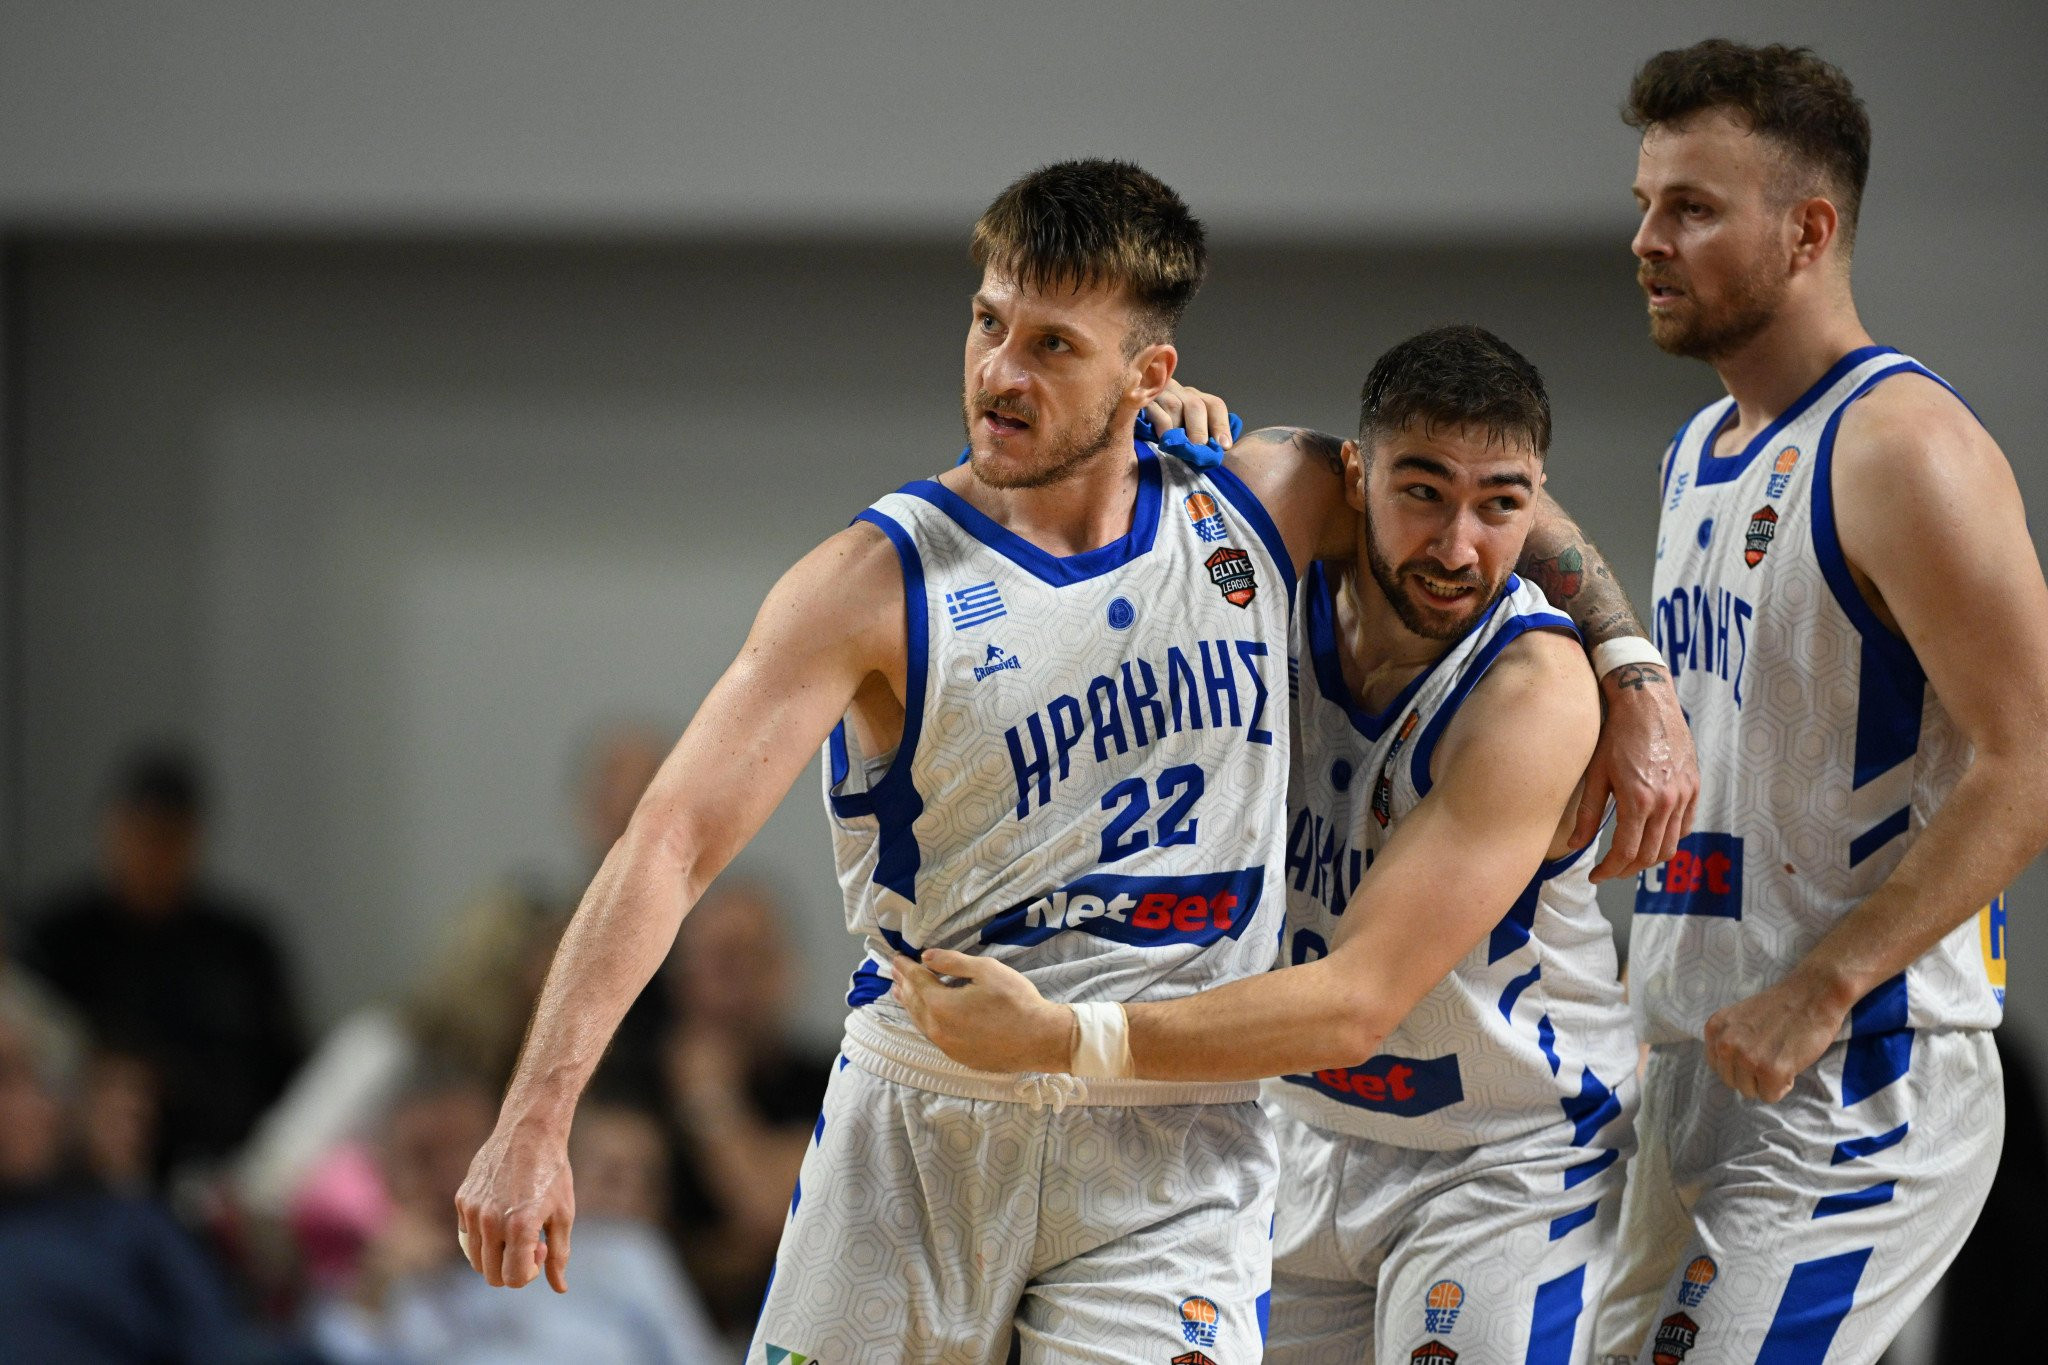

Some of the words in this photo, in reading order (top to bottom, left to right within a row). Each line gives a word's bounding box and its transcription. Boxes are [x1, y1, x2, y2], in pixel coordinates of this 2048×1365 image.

[1748, 520, 1775, 537] ELITE
[1212, 558, 1253, 580] ELITE
[1223, 577, 1254, 593] LEAGUE
[974, 655, 1021, 682] CROSSOVER
[1004, 640, 1272, 821] ΗΡΑΚΛΗΣ
[1098, 763, 1204, 863] 22
[1025, 889, 1238, 931] NetBet
[1297, 1064, 1416, 1102] Bet
[1658, 1326, 1692, 1346] ELITE
